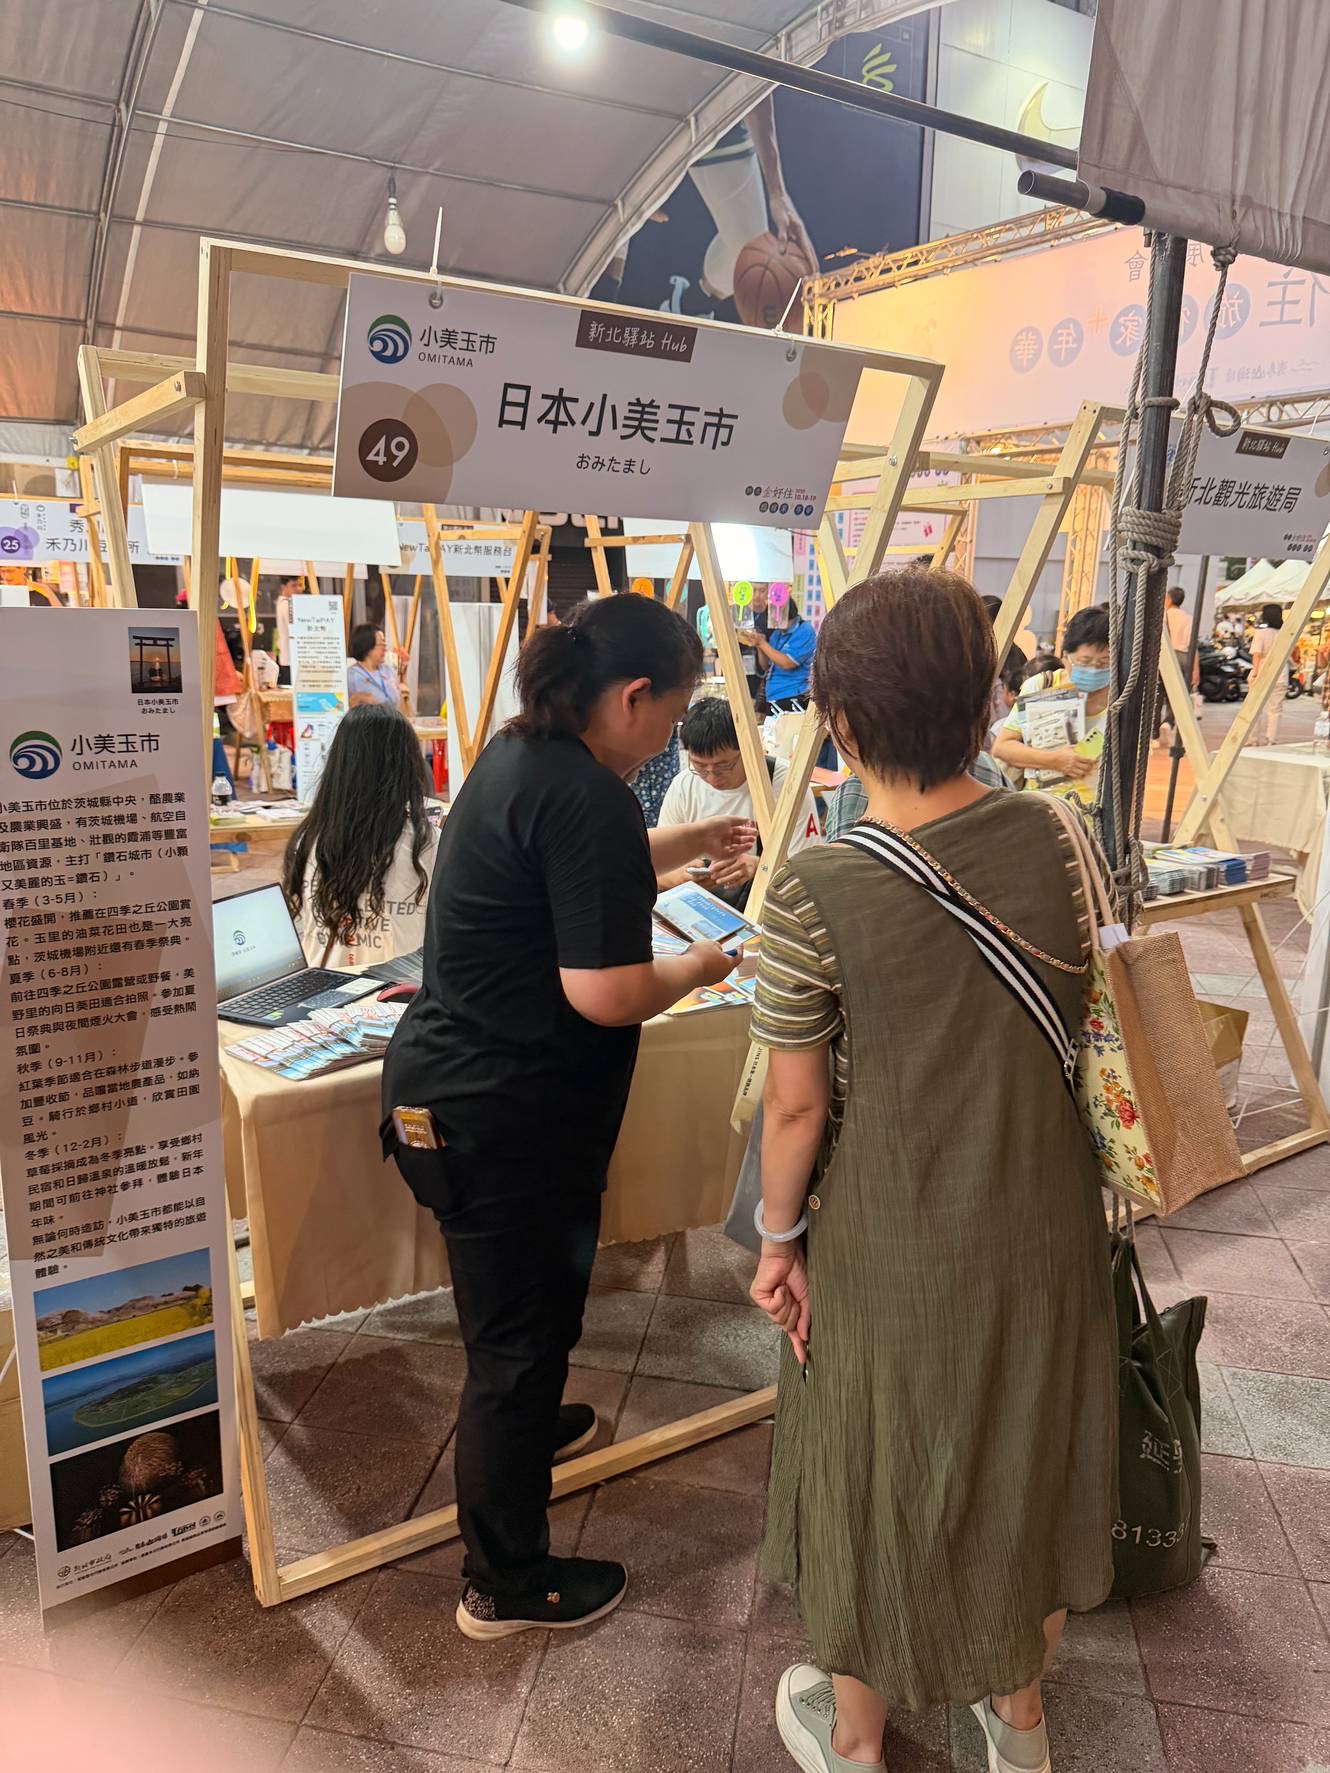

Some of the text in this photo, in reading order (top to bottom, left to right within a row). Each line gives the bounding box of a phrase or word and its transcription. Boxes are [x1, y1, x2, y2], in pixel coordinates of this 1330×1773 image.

[420, 324, 498, 355] 小美玉市
[588, 320, 688, 353] 新北驛站 Hub
[418, 351, 474, 368] OMITAMA
[498, 382, 740, 451] 日本小美玉市
[366, 434, 411, 468] 49
[575, 452, 652, 476] おみたまし
[3, 539, 20, 551] 25
[71, 733, 160, 756] 小美玉市
[72, 759, 138, 771] OMITAMA
